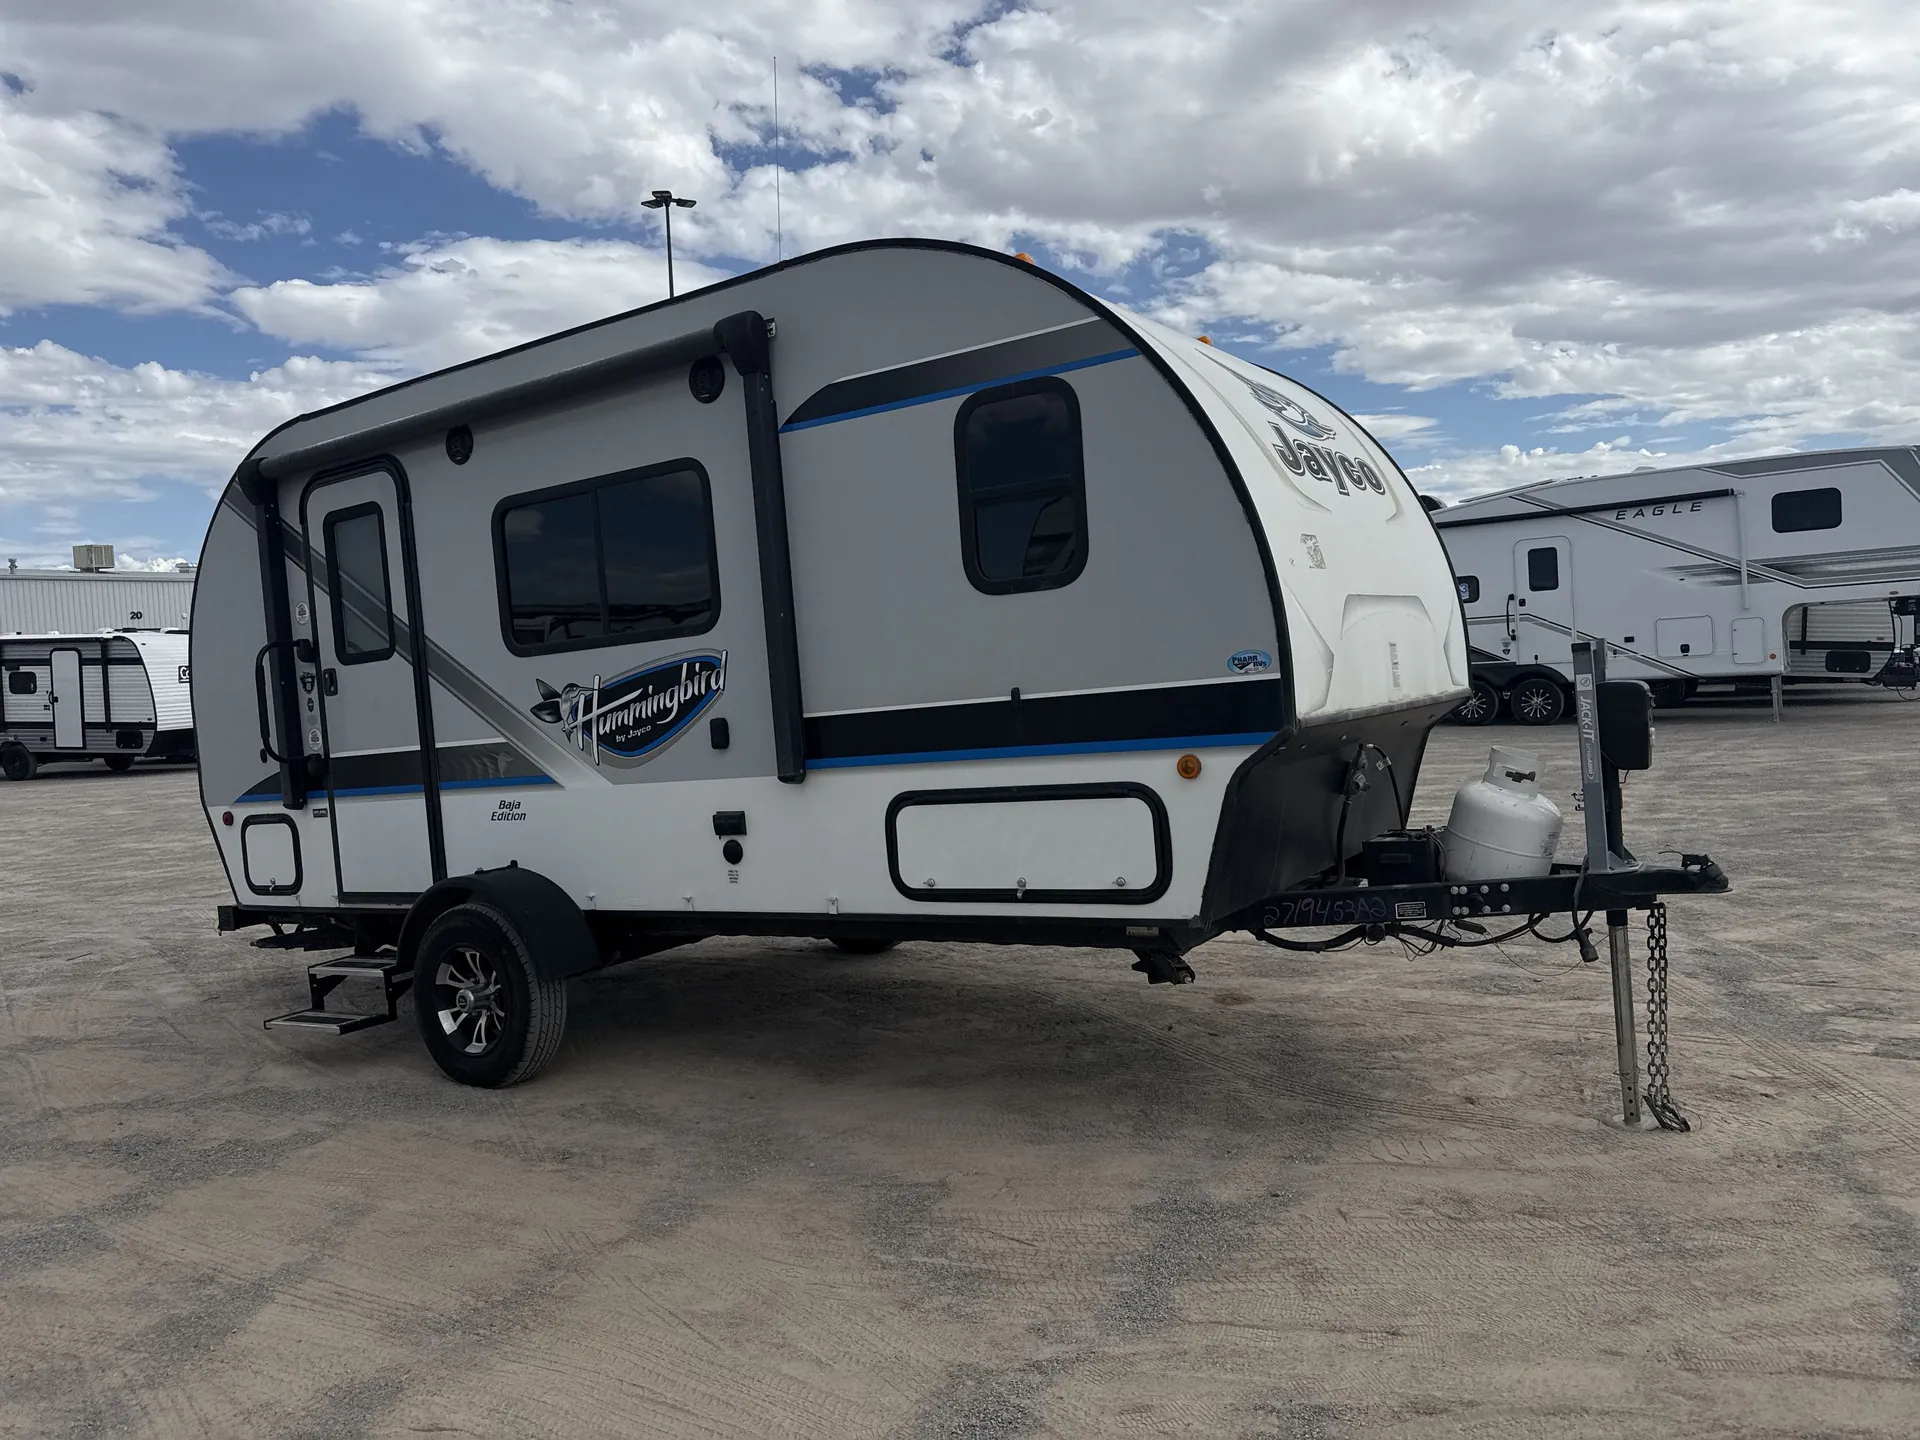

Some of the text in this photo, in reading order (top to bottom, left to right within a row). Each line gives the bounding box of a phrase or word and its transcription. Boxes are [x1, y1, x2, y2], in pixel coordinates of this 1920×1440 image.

[1267, 420, 1386, 497] Jayco
[1615, 501, 1703, 521] EAGLE
[129, 610, 143, 620] 20
[1232, 655, 1258, 664] PHARR
[562, 649, 728, 766] Hummingbird
[1580, 695, 1595, 741] JACK-IT
[615, 725, 652, 743] by Jayco
[498, 799, 521, 811] Baja
[490, 811, 527, 821] Edition
